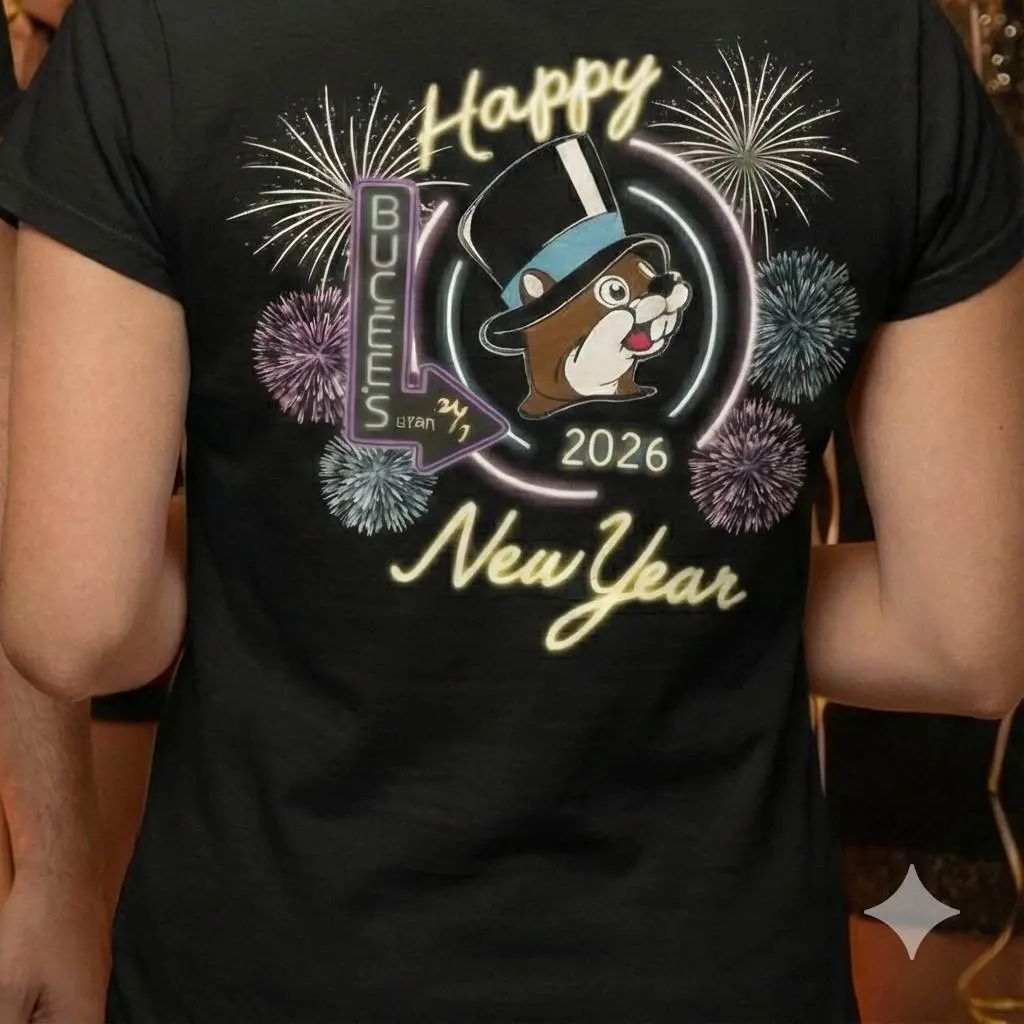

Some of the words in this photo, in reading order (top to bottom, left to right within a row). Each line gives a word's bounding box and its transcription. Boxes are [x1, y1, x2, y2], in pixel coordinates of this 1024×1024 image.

[416, 53, 663, 172] Happy
[561, 427, 669, 473] 2026
[389, 501, 586, 589] New
[544, 510, 748, 652] Year
